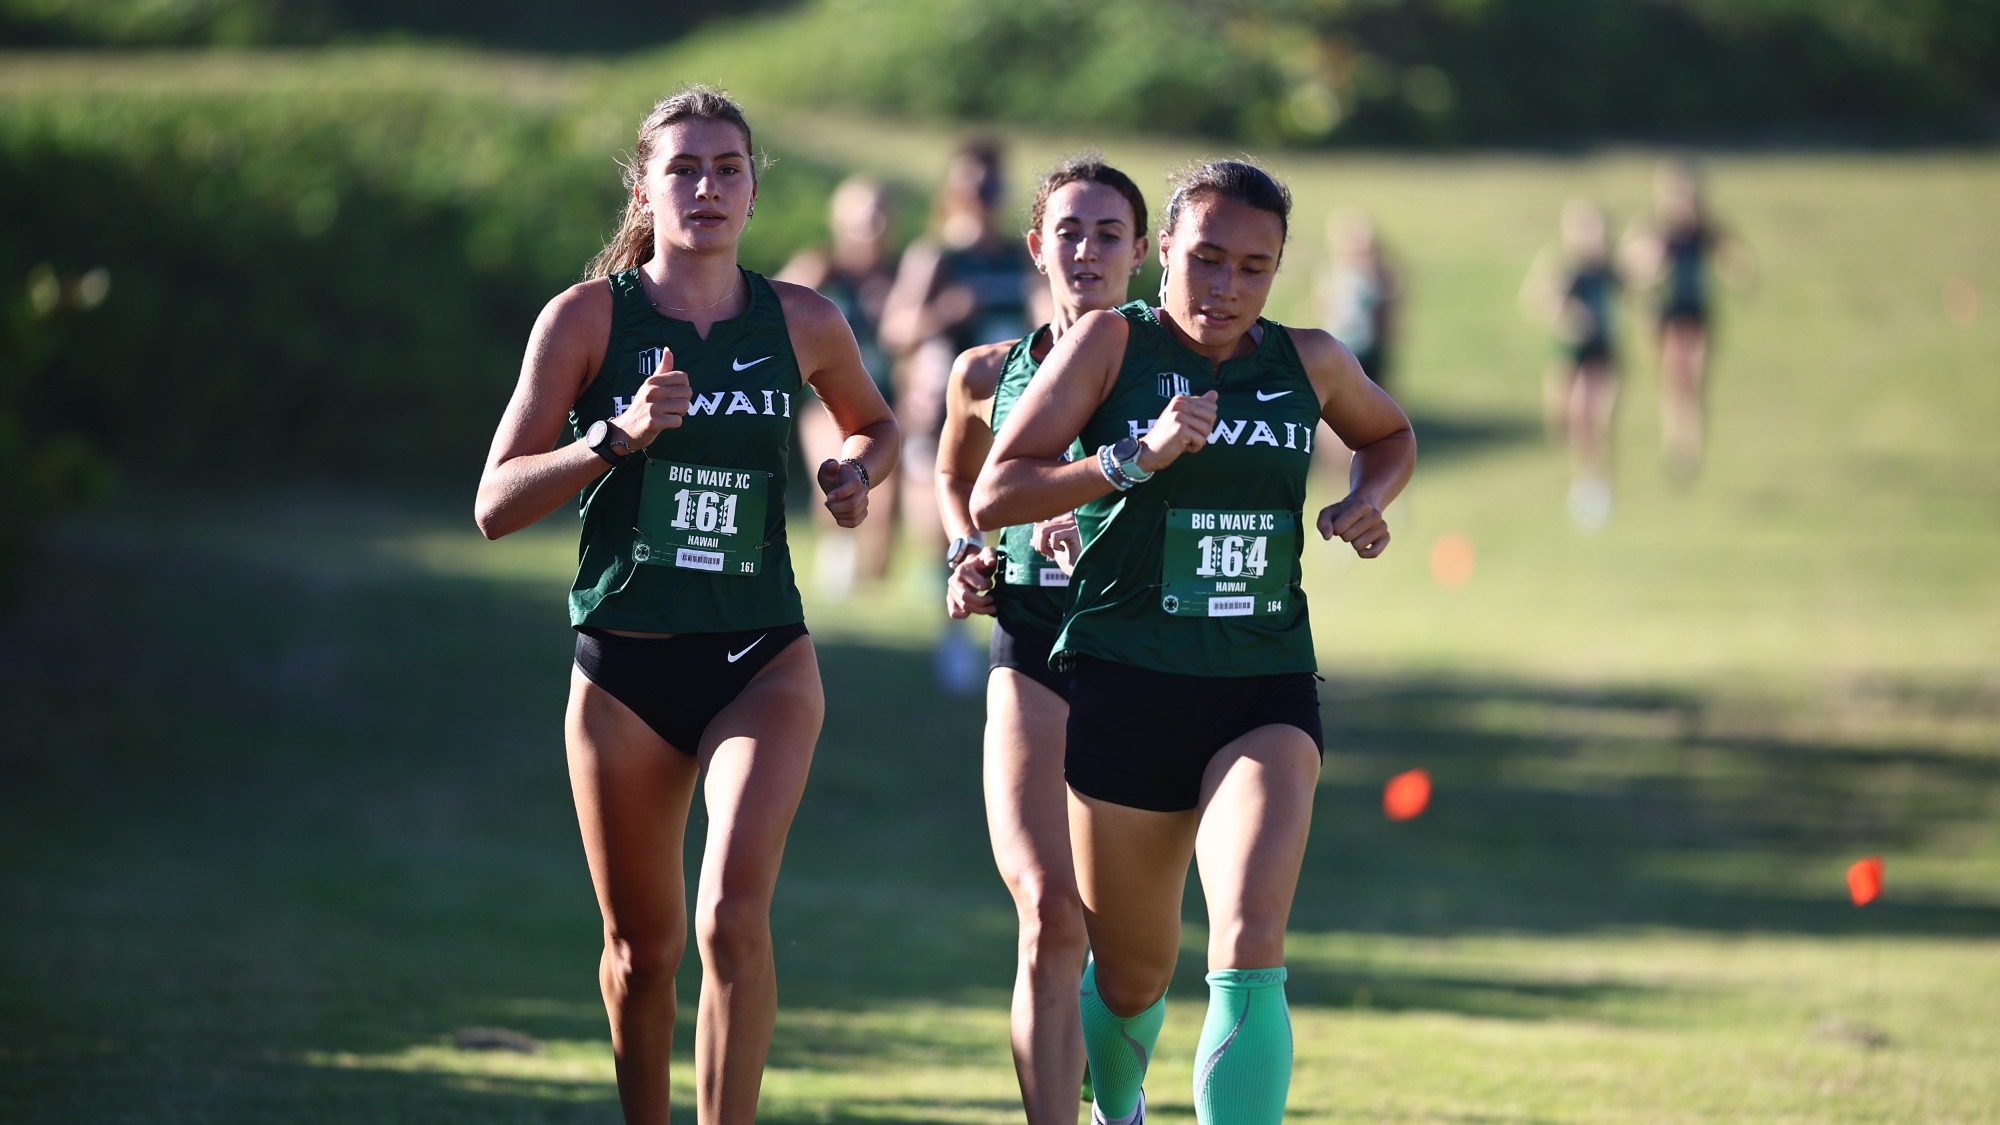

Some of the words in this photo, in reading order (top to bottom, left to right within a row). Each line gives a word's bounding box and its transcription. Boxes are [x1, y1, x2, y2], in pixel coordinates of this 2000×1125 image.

[613, 389, 791, 418] HWAI'I
[1127, 419, 1311, 454] HWAI'I
[669, 466, 692, 483] BIG
[697, 469, 732, 488] WAVE
[735, 473, 750, 489] XC
[671, 489, 738, 534] 161
[1192, 513, 1215, 529] BIG
[1220, 514, 1256, 530] WAVE
[1260, 514, 1274, 530] XC
[688, 535, 719, 548] HAWAII
[1196, 536, 1268, 577] 164
[740, 562, 754, 573] 161
[1216, 582, 1246, 592] HAWAII
[1267, 601, 1282, 612] 164
